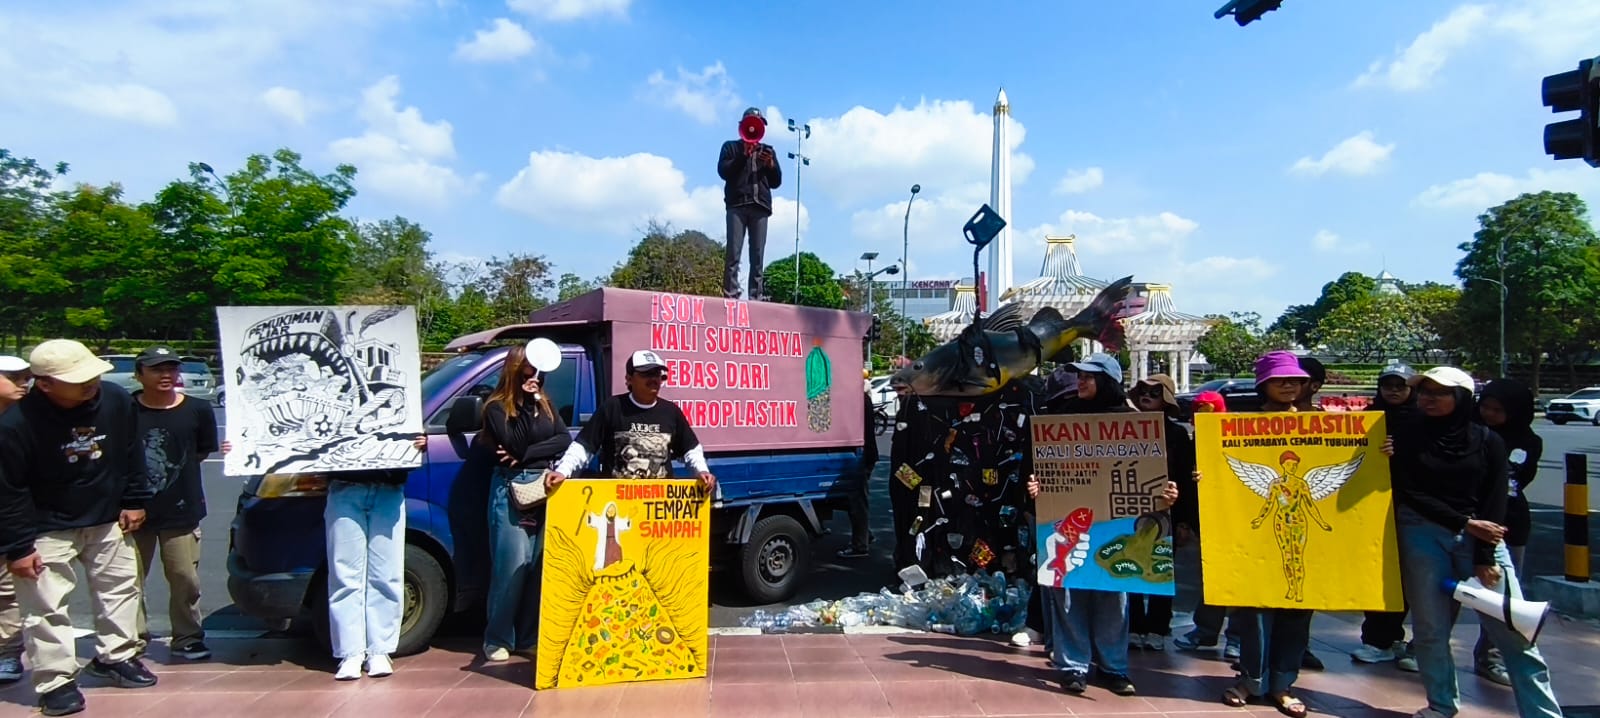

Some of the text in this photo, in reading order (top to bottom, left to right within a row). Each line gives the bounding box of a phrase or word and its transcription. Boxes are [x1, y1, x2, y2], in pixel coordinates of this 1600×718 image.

[911, 281, 950, 289] KENCANA
[724, 299, 750, 328] TA
[249, 310, 324, 339] PEMUKIMAN
[259, 325, 290, 341] LIAR
[651, 322, 803, 358] KALI SURABAYA
[662, 359, 770, 390] EBAS DARI
[1033, 420, 1161, 442] IKAN MATI
[1221, 414, 1367, 436] MIKROPLASTIK
[1035, 441, 1163, 459] KALI SURABAYA
[1222, 436, 1369, 448] KALI SURABAYA CEMARI TUBUHMU
[1074, 470, 1098, 478] JATIM
[616, 484, 704, 500] SUNGAI BUKAN
[1039, 485, 1073, 493] NDUSTRI
[643, 500, 704, 520] TEMPAT
[639, 520, 702, 538] SAMPAH
